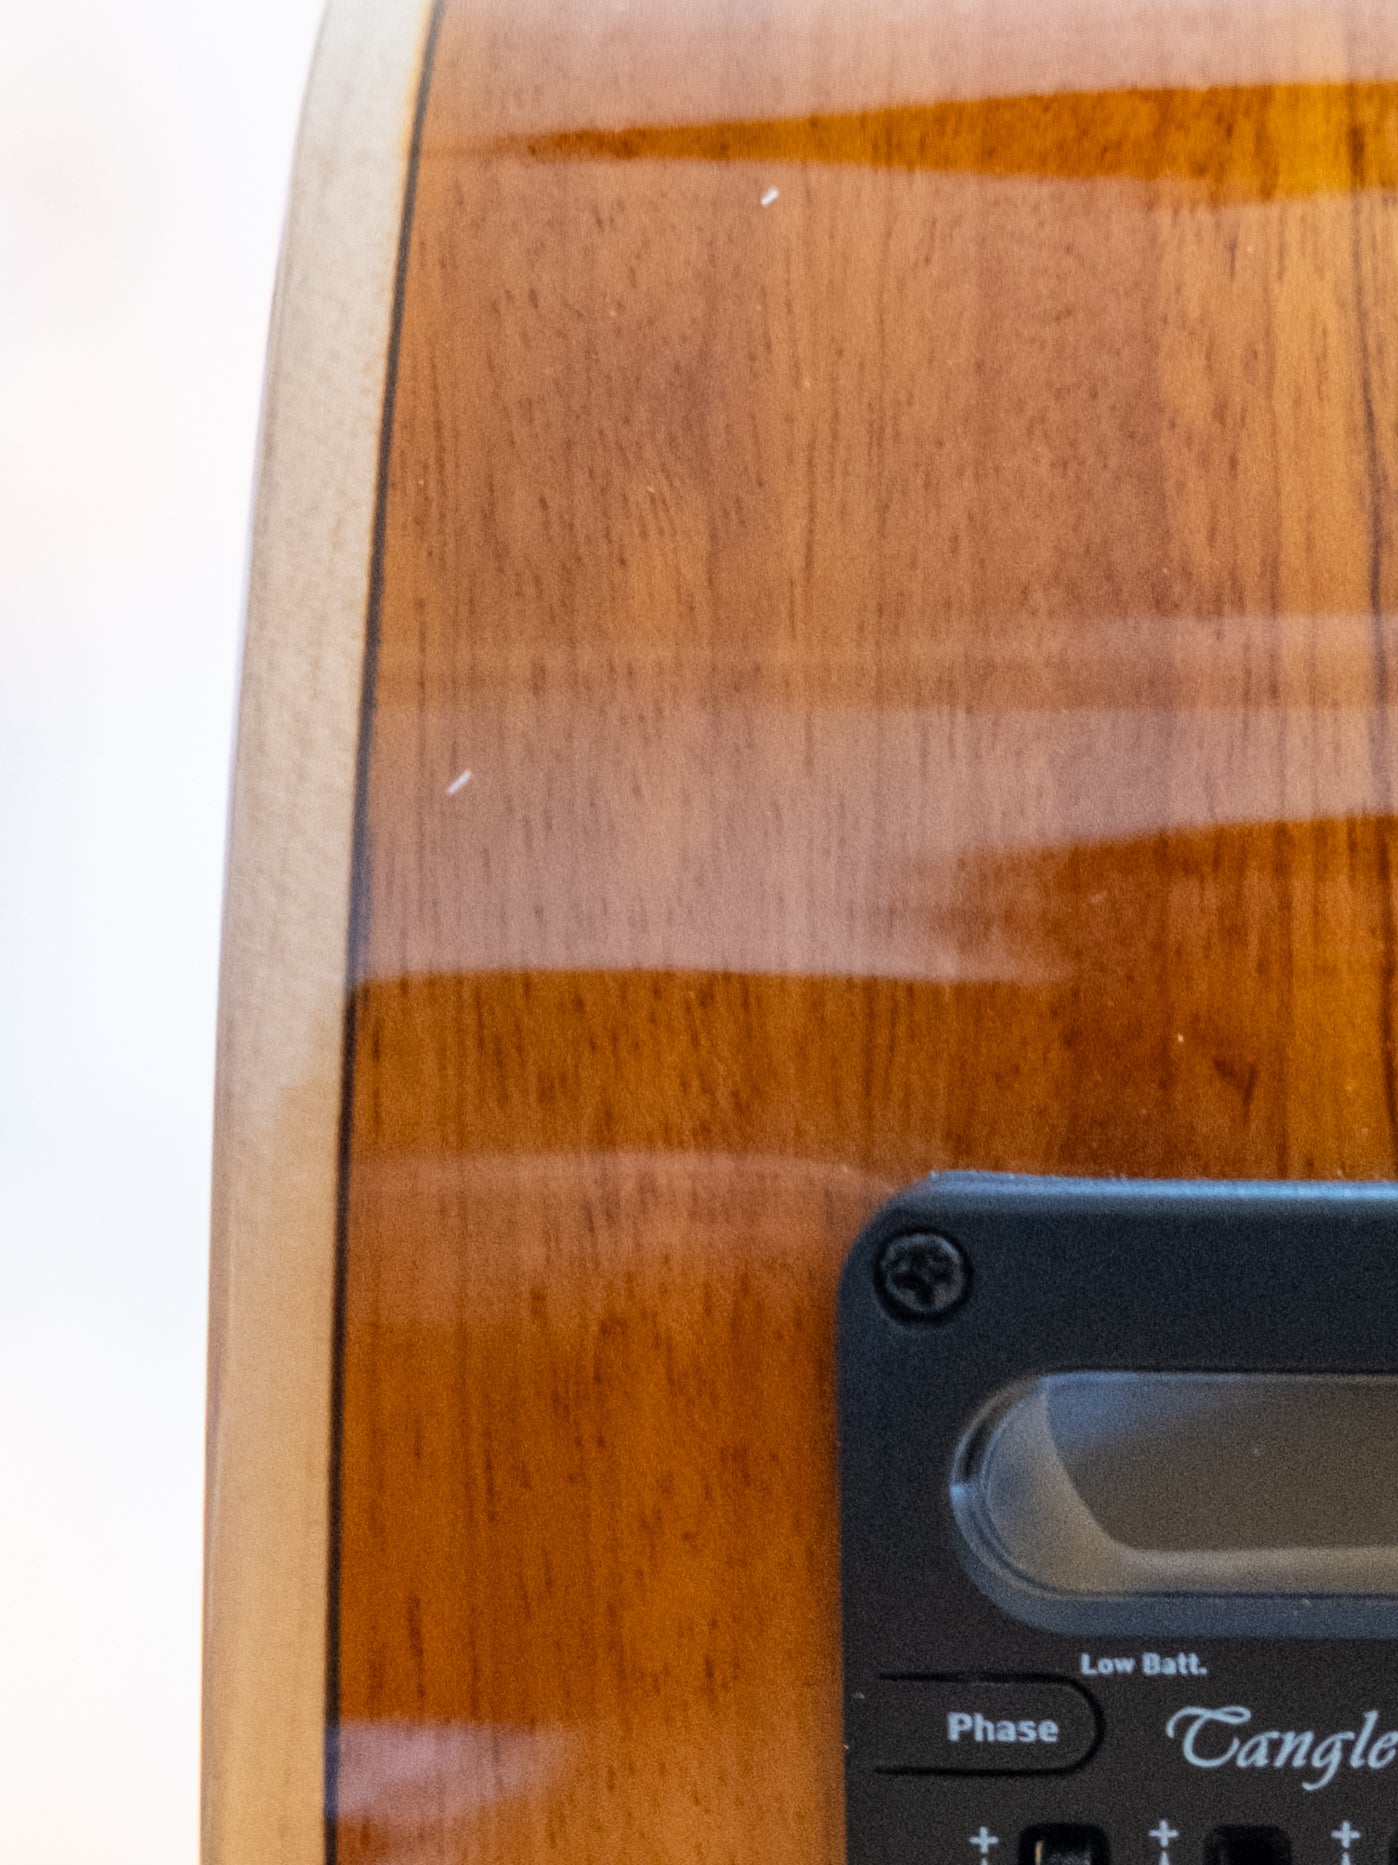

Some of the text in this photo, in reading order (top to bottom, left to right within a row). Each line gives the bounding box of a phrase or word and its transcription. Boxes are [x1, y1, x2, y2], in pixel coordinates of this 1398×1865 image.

[1081, 1652, 1208, 1676] Low Batt.
[947, 1712, 1059, 1743] Phase
